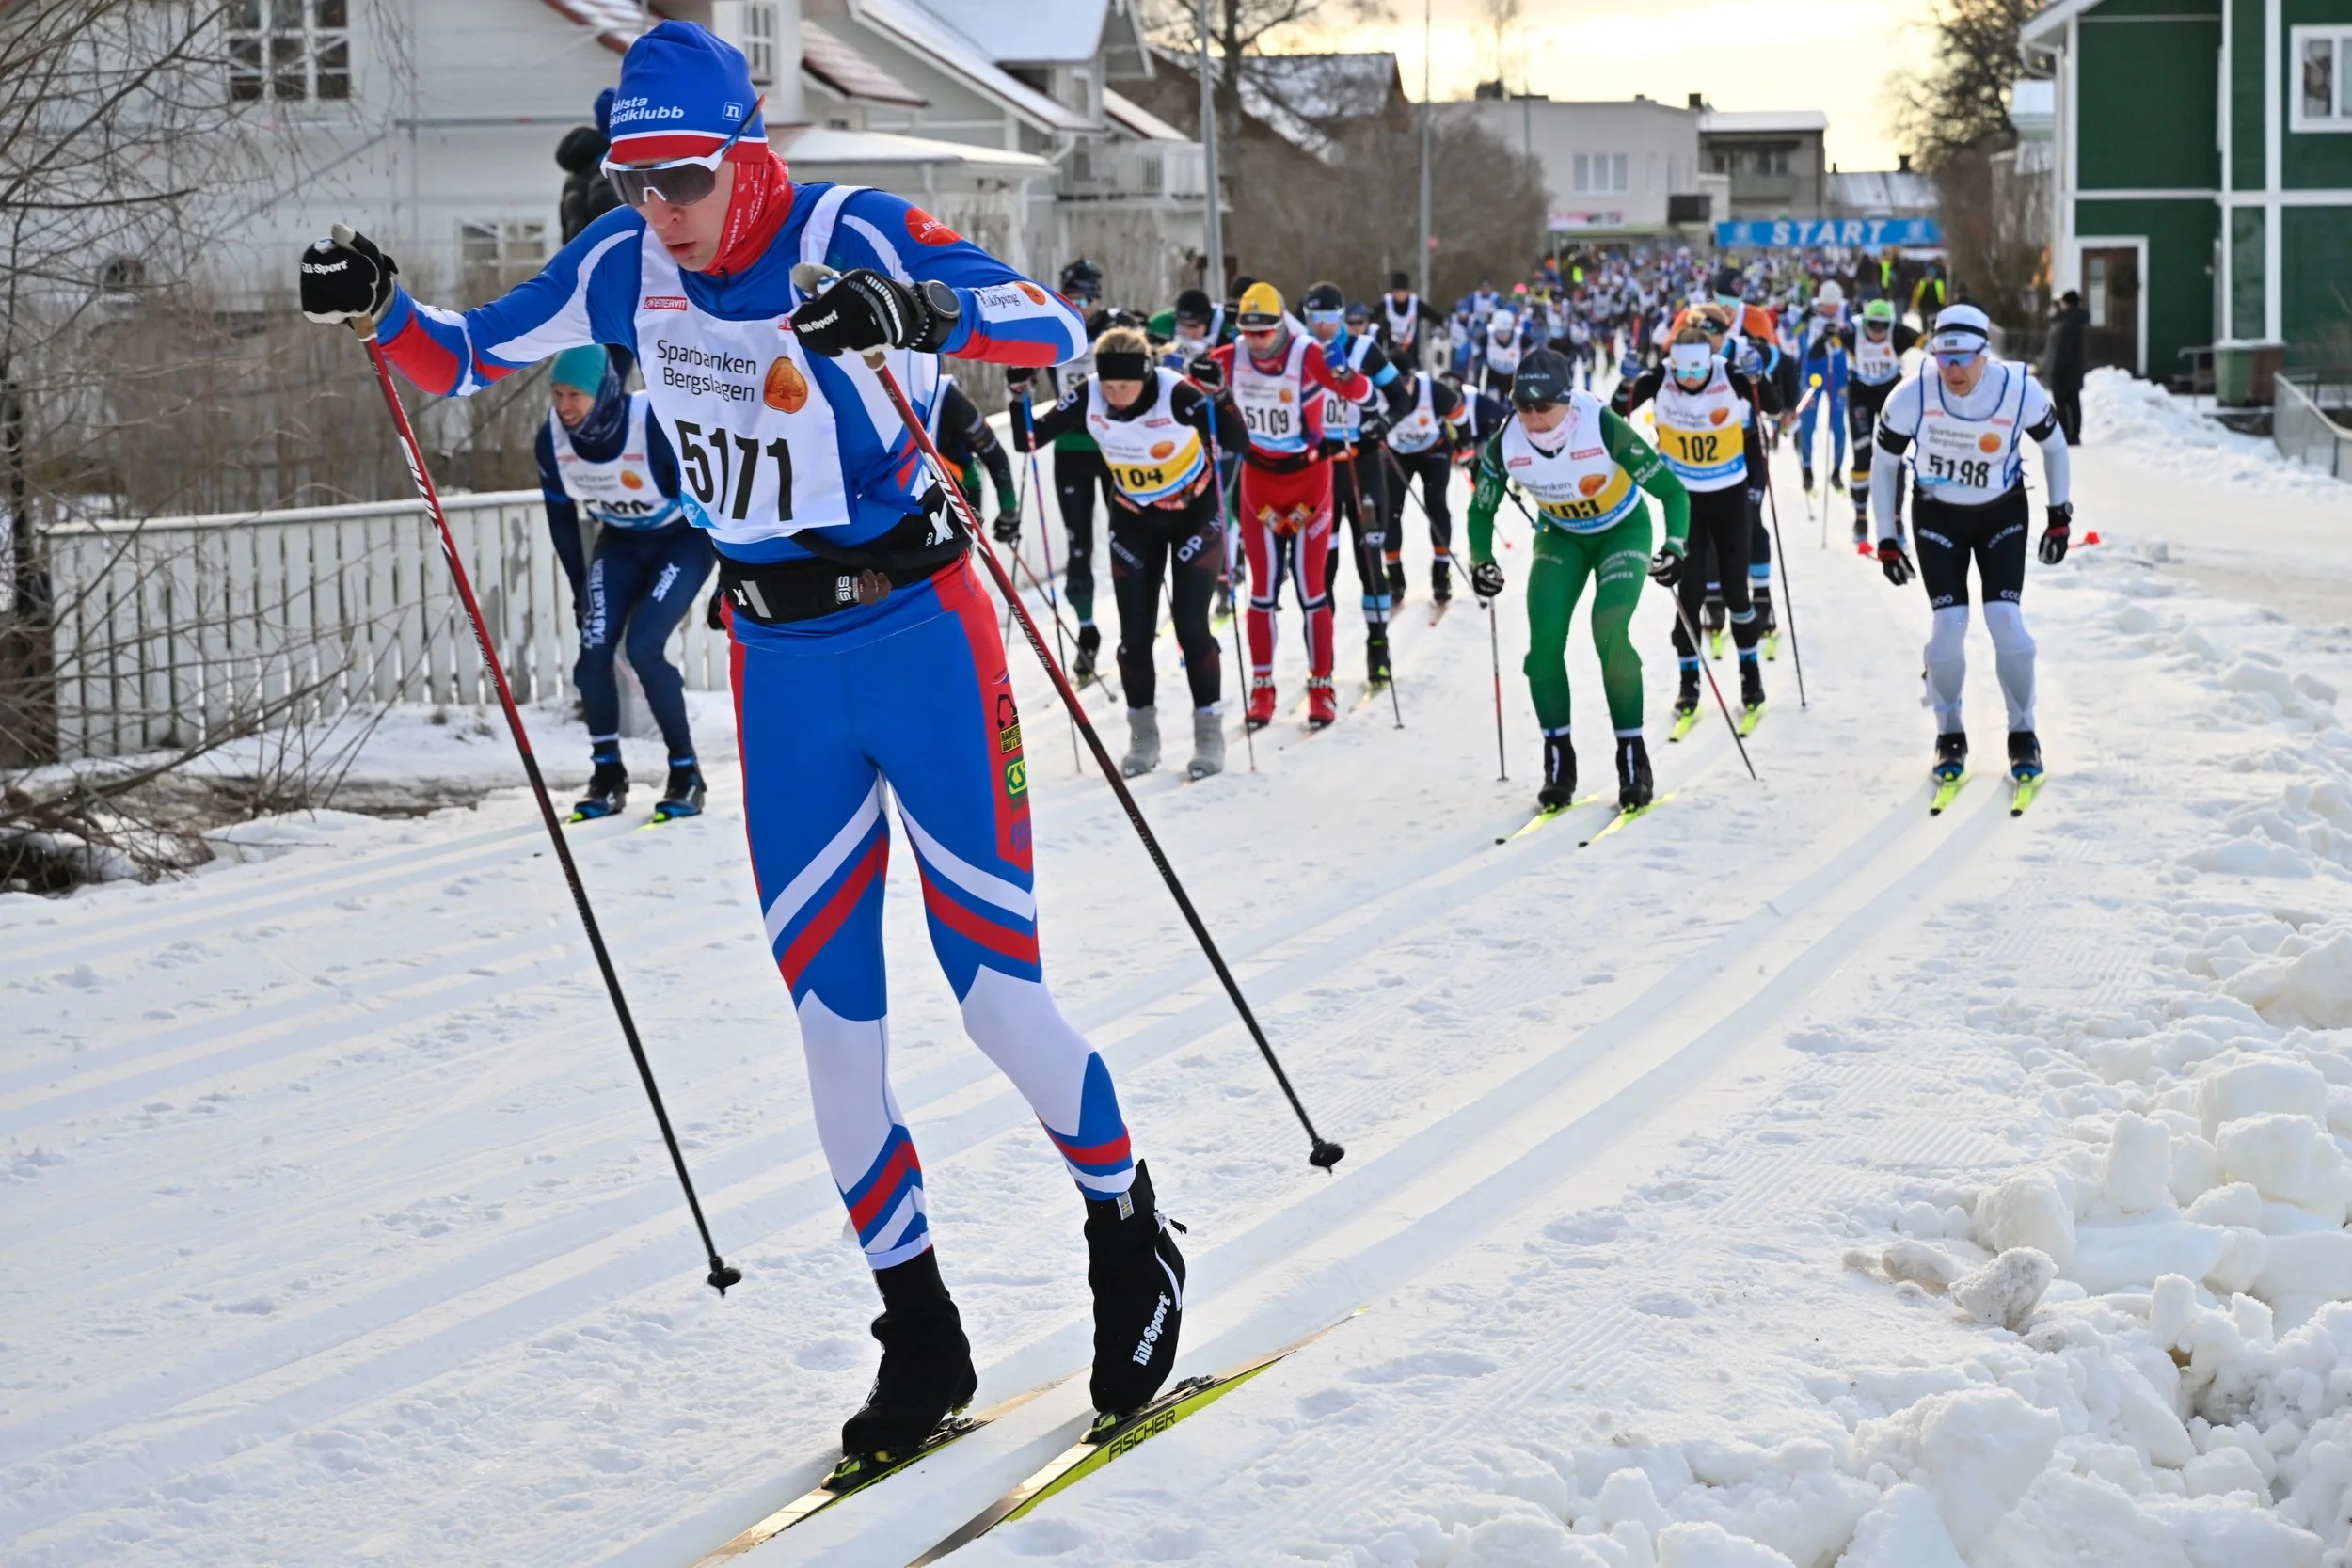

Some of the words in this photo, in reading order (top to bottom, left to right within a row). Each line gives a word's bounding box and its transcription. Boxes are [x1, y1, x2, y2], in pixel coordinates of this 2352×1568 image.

[1772, 220, 1888, 245] START
[655, 297, 687, 309] ENERVIT
[657, 340, 757, 376] Sparbanken
[663, 367, 755, 403] Bergslagen
[1245, 406, 1290, 436] 5109
[1678, 435, 1719, 463] 102
[675, 418, 794, 522] 5171
[1115, 468, 1163, 488] 104
[1928, 453, 1991, 488] 5198
[1108, 1409, 1176, 1463] FISCHER
